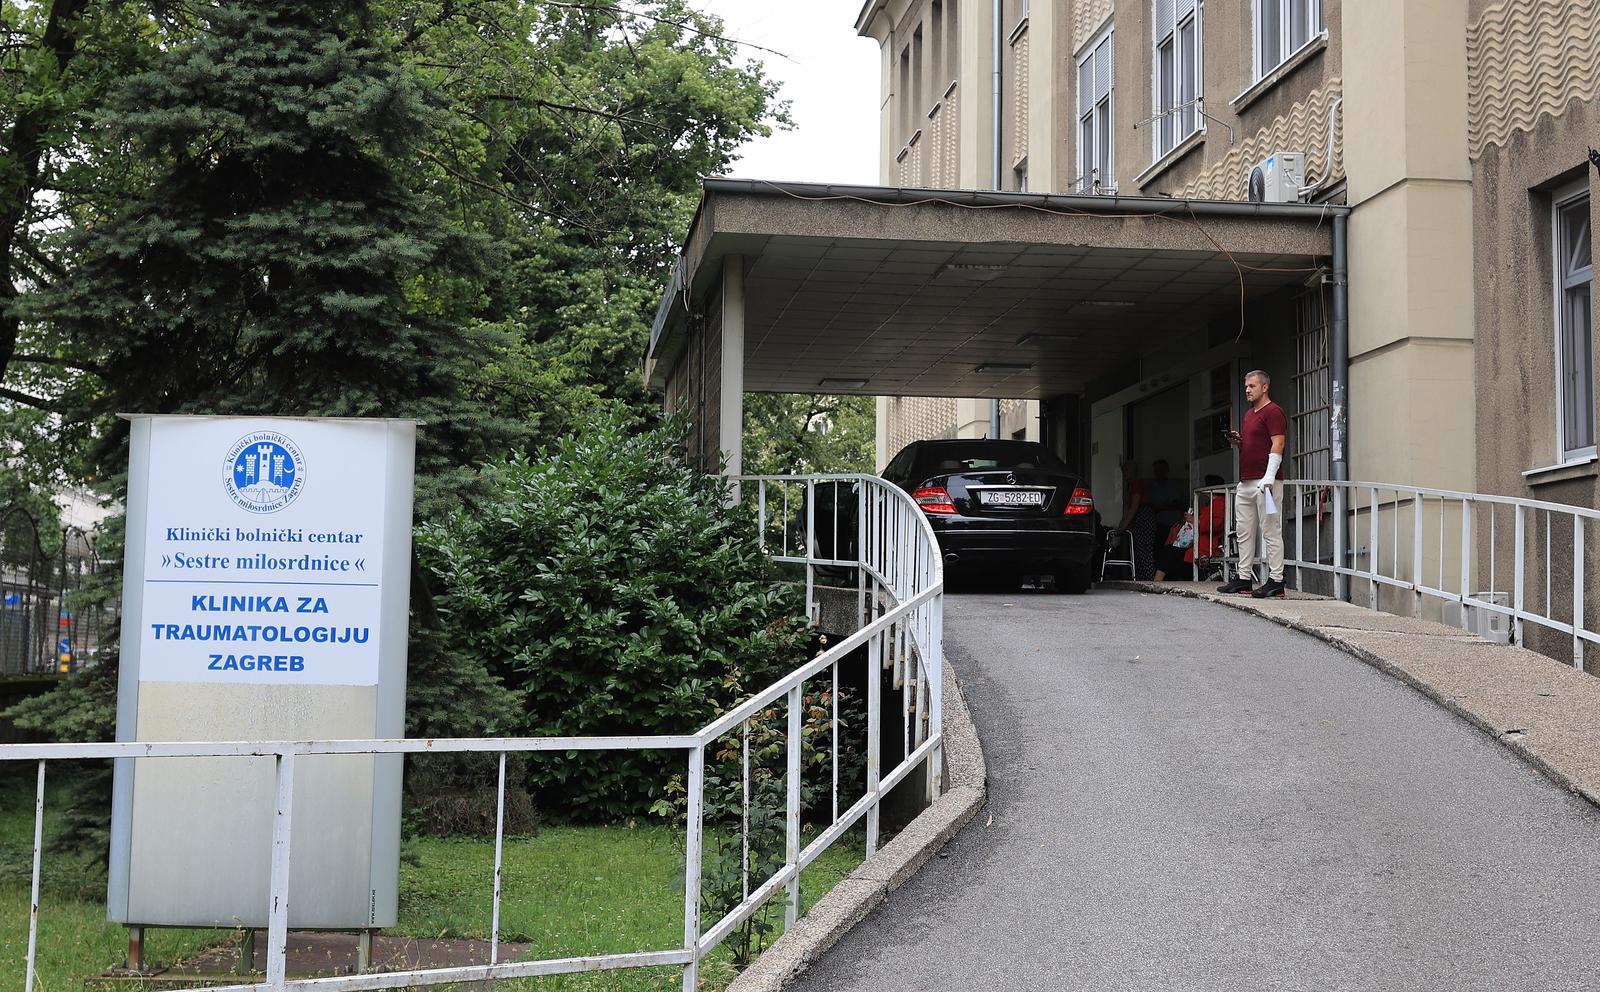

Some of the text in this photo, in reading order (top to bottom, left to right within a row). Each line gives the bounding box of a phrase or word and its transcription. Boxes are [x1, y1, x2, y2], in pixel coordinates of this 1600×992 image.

[226, 433, 303, 466] Klinički bolnički centar
[225, 477, 303, 512] Sestre milosrdnice Zagreb
[987, 492, 999, 503] ZG
[166, 527, 363, 544] Klinički bolnički centar
[191, 595, 329, 614] KLINIKA ZA
[151, 623, 369, 644] TRAUMATOLOGIJU
[207, 654, 305, 672] ZAGREB
